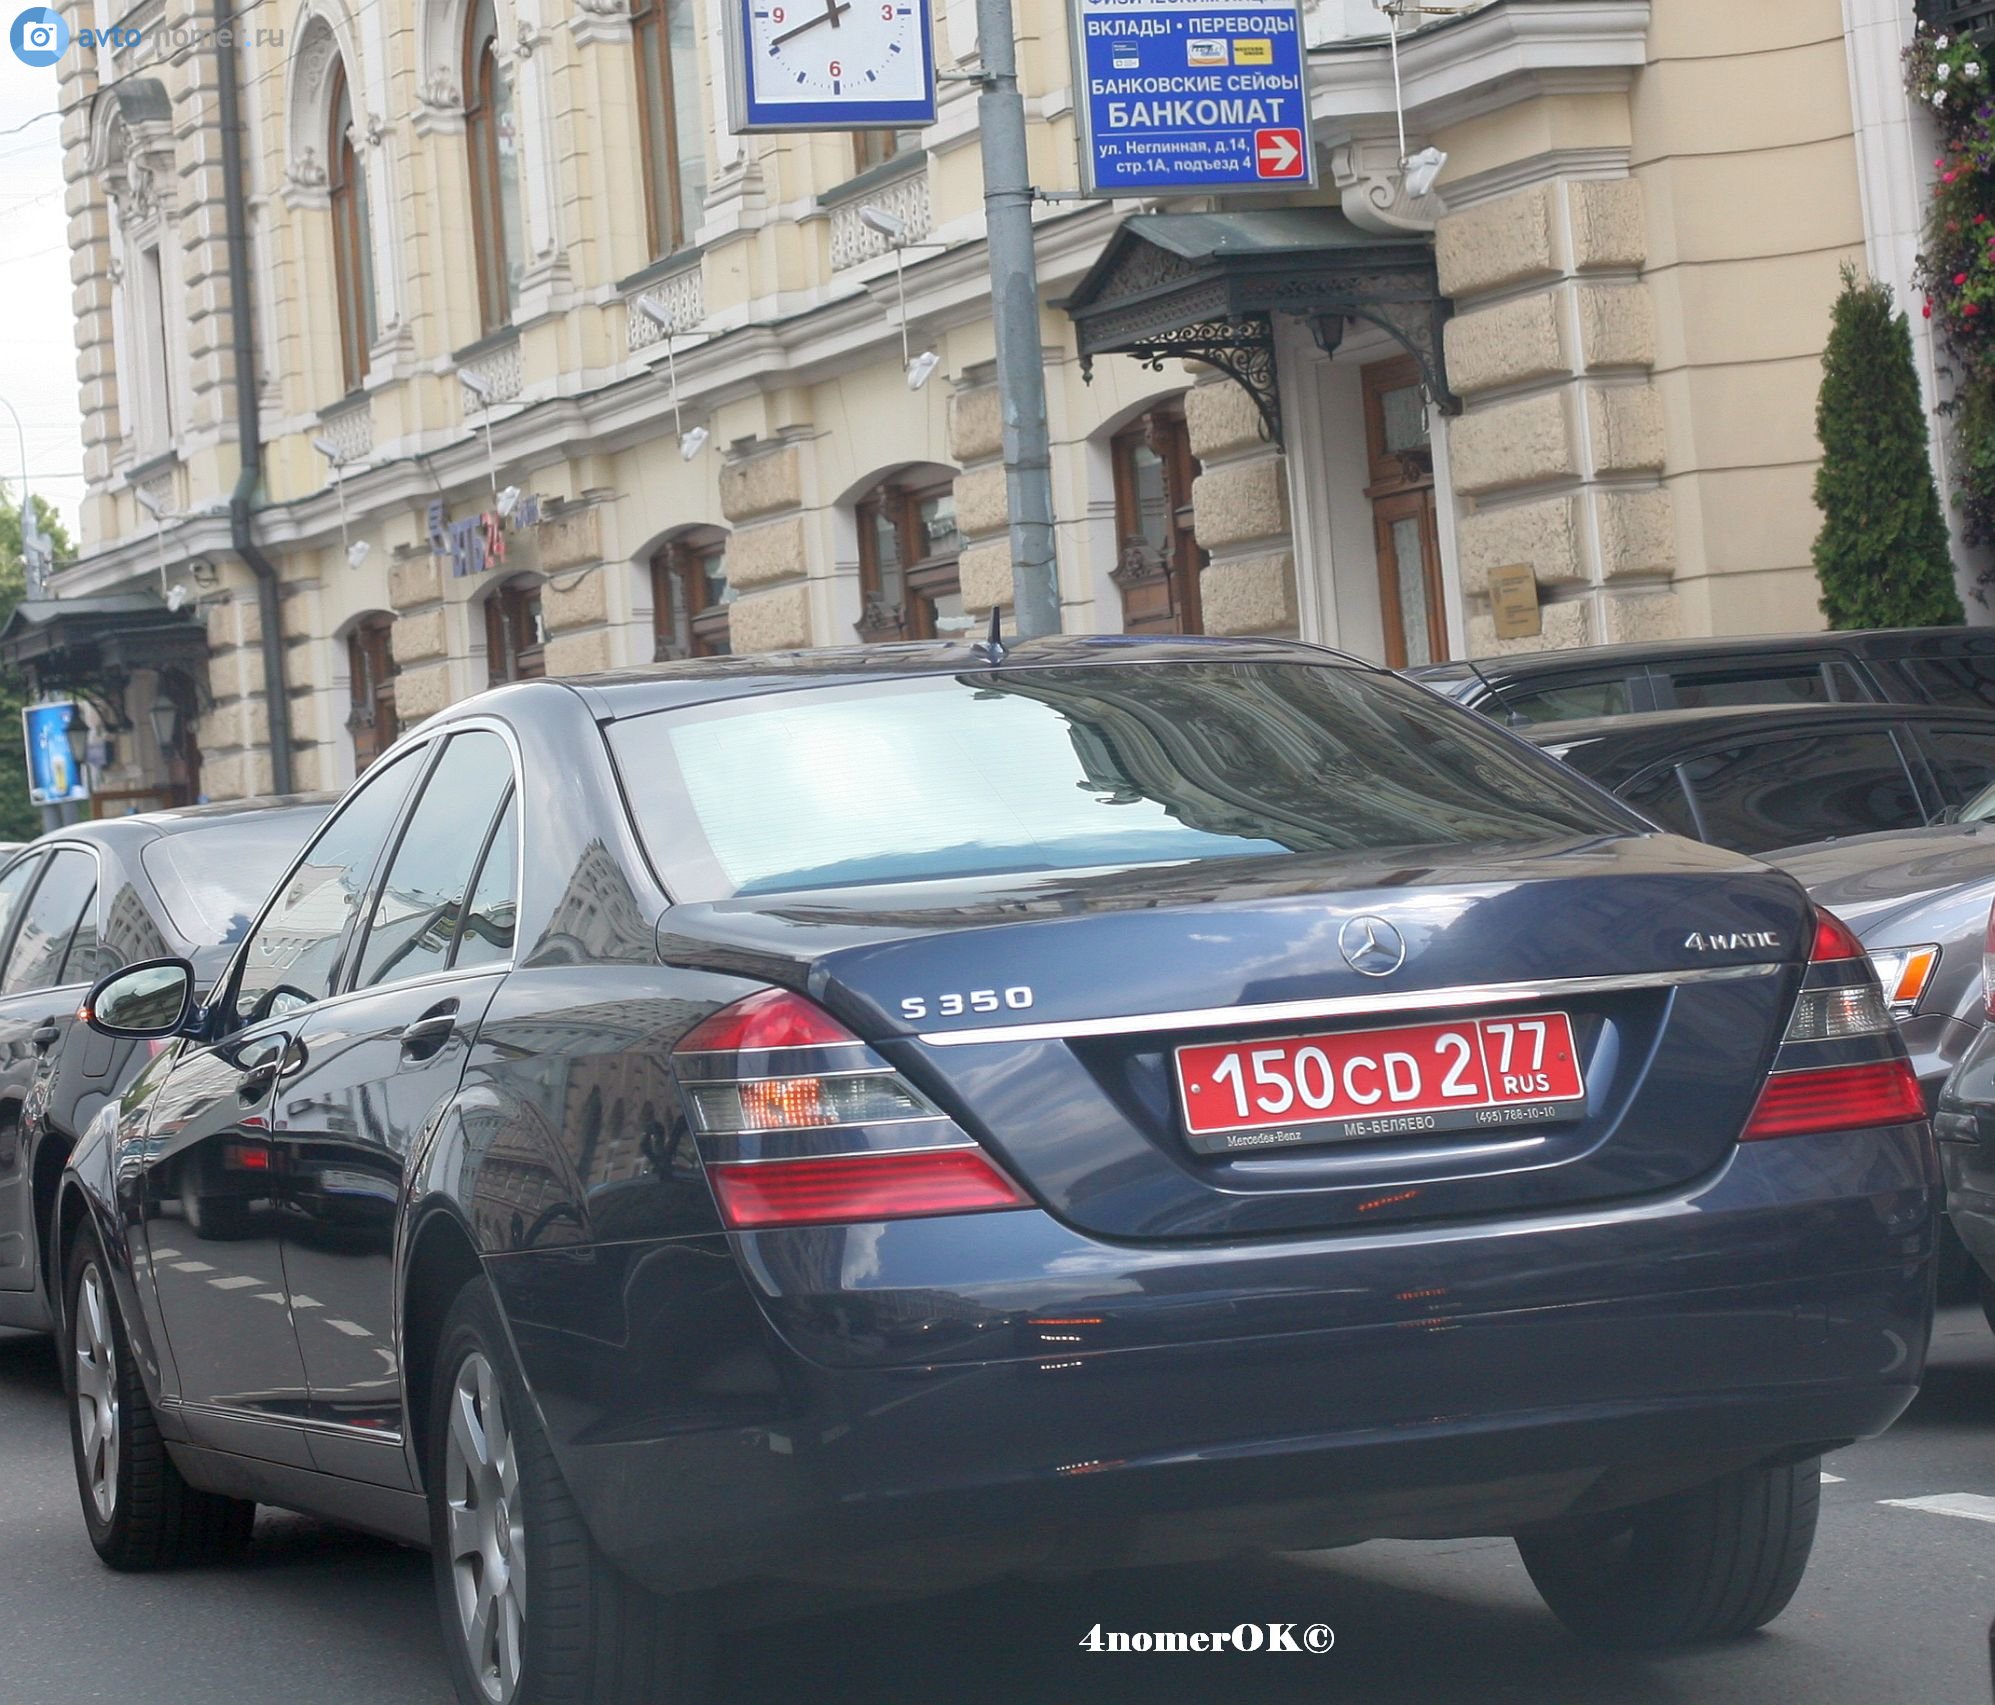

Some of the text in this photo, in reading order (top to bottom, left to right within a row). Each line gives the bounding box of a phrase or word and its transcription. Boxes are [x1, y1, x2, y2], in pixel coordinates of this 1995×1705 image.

[772, 4, 893, 23] 9 3
[1087, 16, 1295, 37] ВКЛАДЫ ПЕРЕВОДЫ
[829, 60, 841, 77] 6
[1092, 72, 1299, 95] БАНКОВСКИЕ СЕЙФЫ
[1108, 98, 1285, 128] БАНКОМАТ
[1099, 138, 1251, 158] ул. Неглинная, д.14,
[1116, 157, 1252, 175] стр.1А, подъезд 4
[901, 986, 1033, 1019] S 350
[1486, 1021, 1546, 1073] 77
[1503, 1073, 1550, 1095] RUS
[1344, 1116, 1435, 1137] МБ-БЕЛЯЕВО
[1475, 1106, 1556, 1126] (495) 788-10-10
